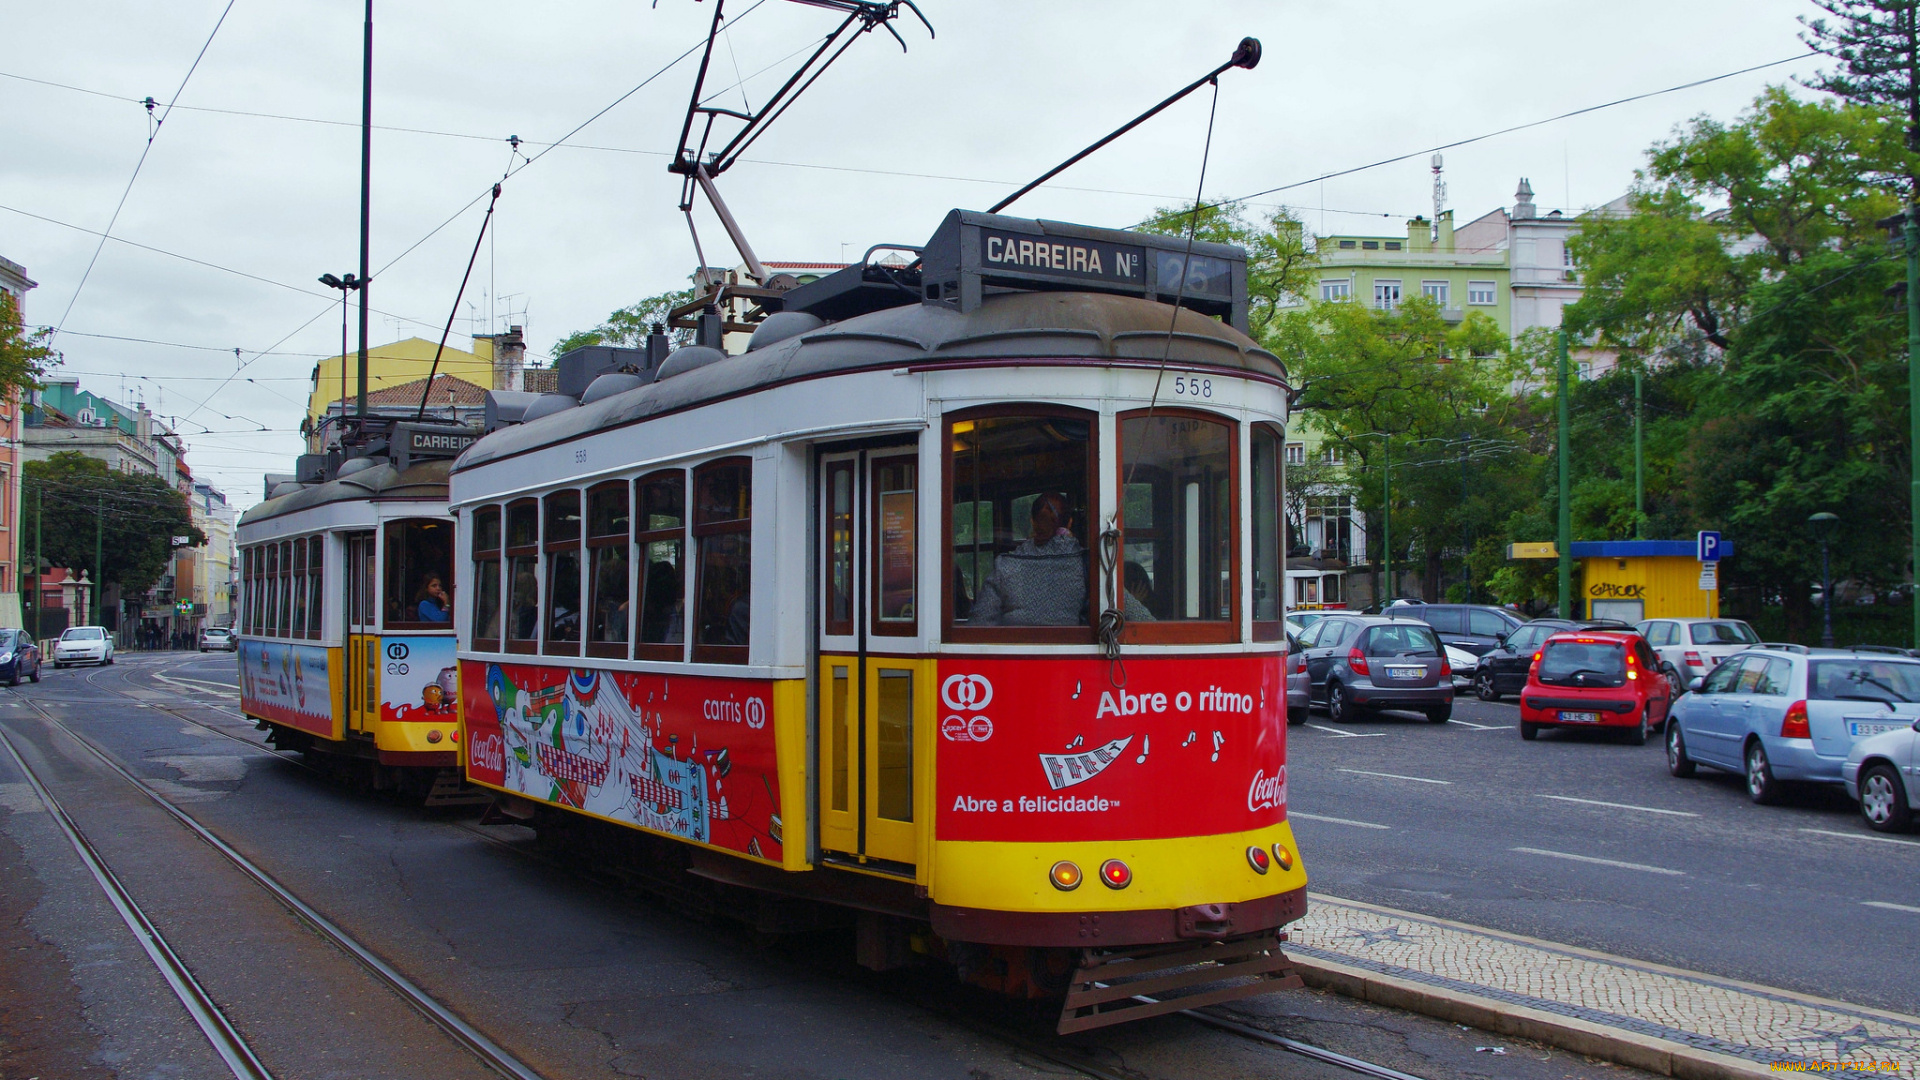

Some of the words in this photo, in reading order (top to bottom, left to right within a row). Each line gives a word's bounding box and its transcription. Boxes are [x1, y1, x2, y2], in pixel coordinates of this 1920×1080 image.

[986, 236, 1102, 275] CARREIRA
[1164, 257, 1207, 293] 25
[1175, 376, 1212, 398] 558
[413, 434, 477, 449] CARREIR
[1704, 536, 1717, 557] P
[703, 692, 742, 723] carris
[1096, 690, 1167, 719] Abre
[1175, 691, 1193, 711] o
[1199, 685, 1253, 714] ritmo
[953, 795, 997, 812] Abre
[1002, 799, 1014, 812] a
